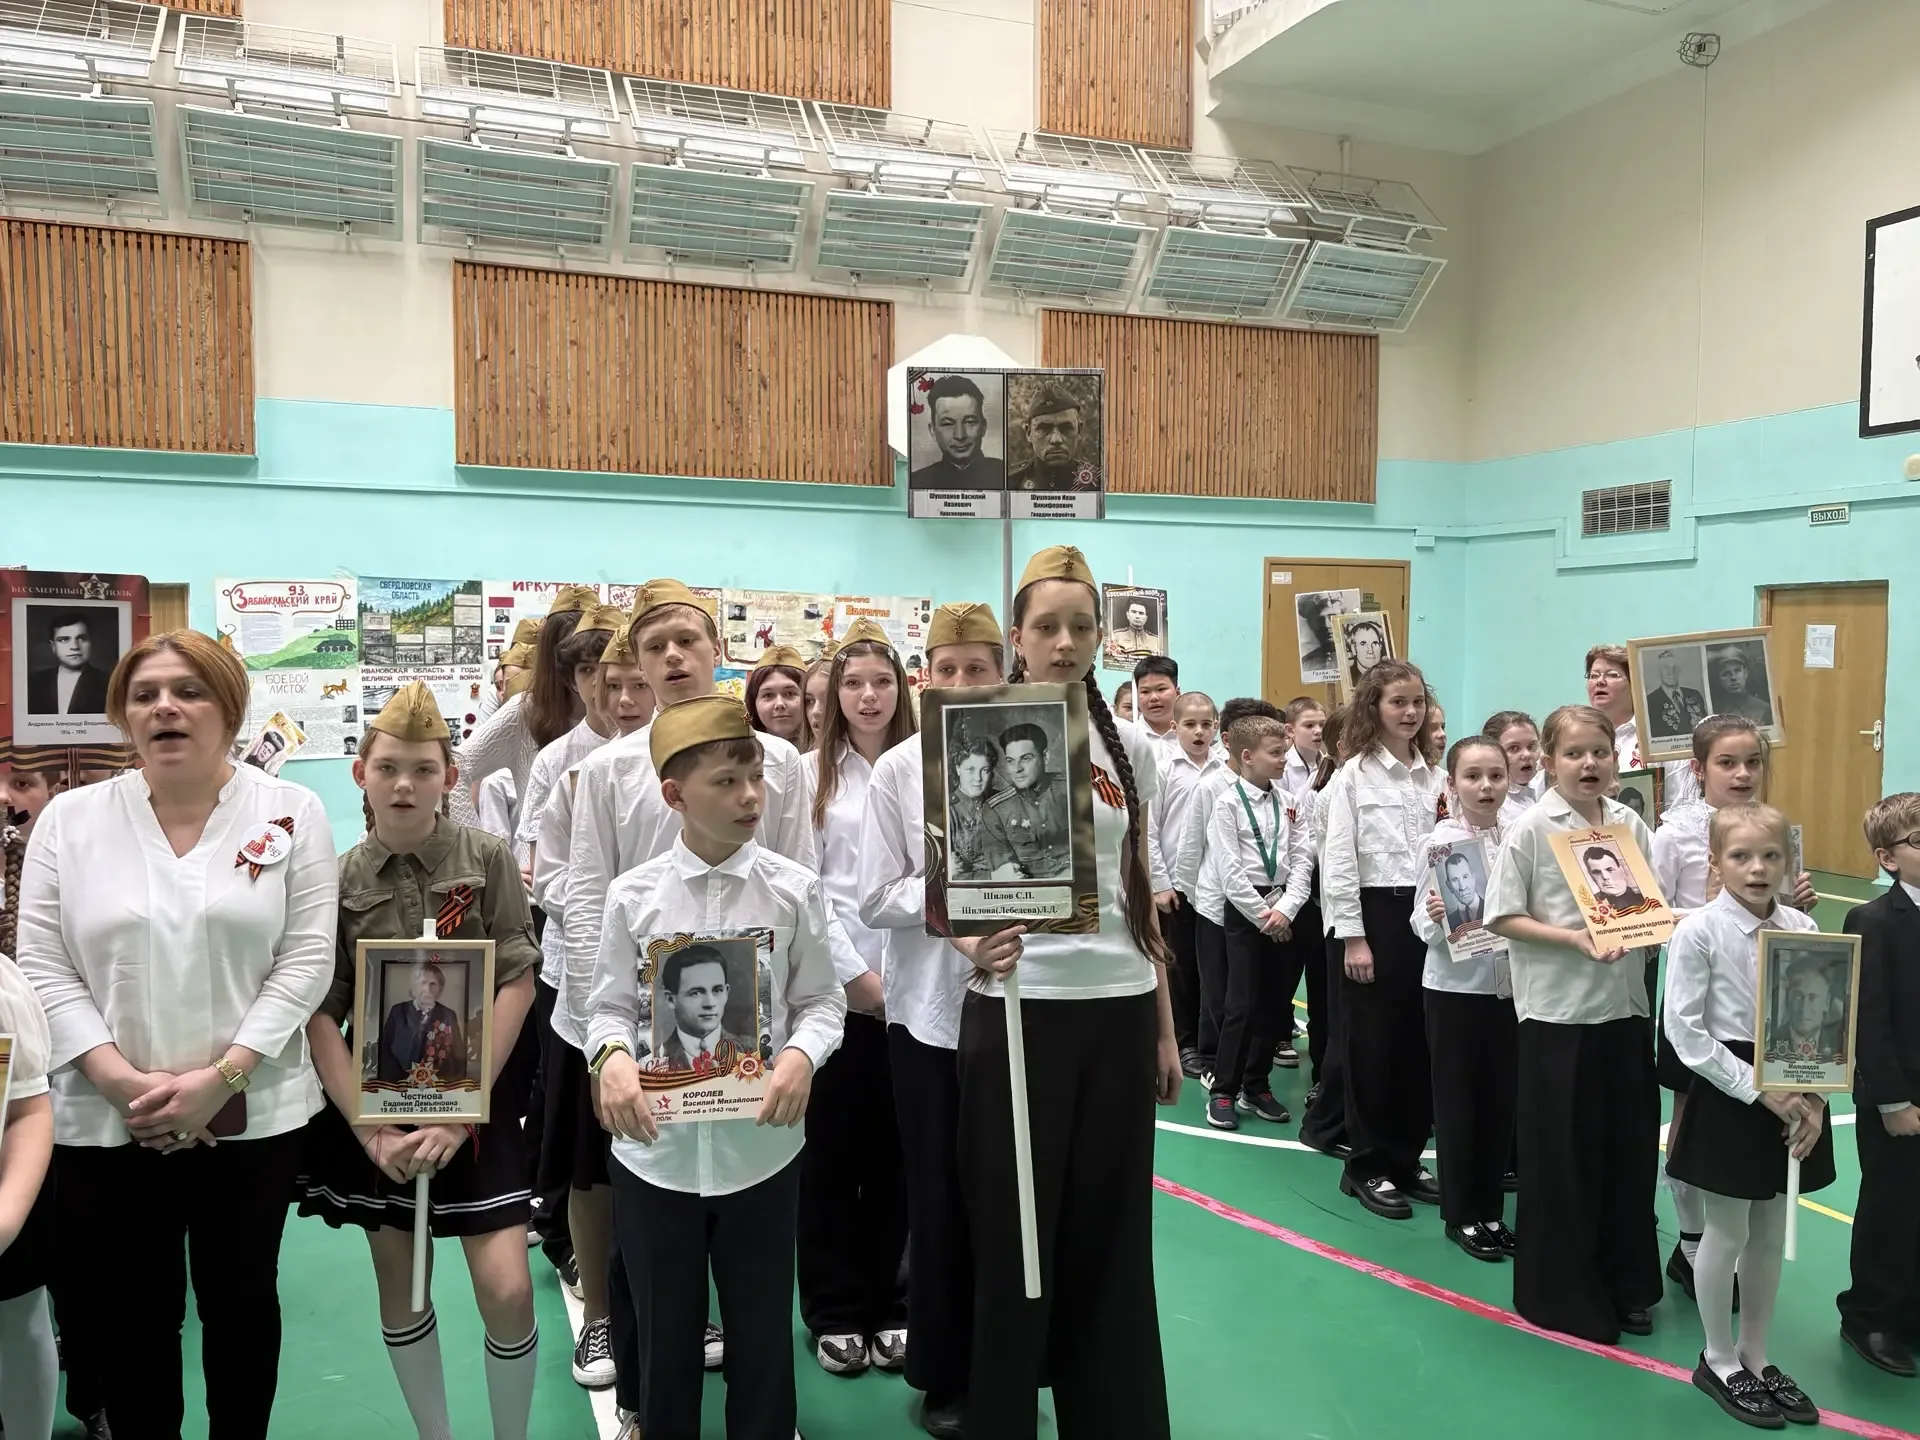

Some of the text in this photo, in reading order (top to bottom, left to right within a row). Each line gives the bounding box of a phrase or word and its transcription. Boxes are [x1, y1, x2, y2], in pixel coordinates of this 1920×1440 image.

[1812, 510, 1846, 522] ВЫХОД
[11, 586, 83, 595] БЕССМЕРТНЫЙ
[380, 581, 432, 591] СВЕРДЛОВСКАЯ
[512, 581, 601, 595] ИРКУТЯ
[314, 592, 338, 605] КРАЙ
[391, 591, 421, 600] ОБЛАСТЬ
[265, 673, 310, 684] БОЕВОЙ
[361, 674, 393, 682] ВЕЛИКОЙ
[397, 673, 454, 681] ОТЕЧЕСТВЕННОЙ
[269, 684, 308, 695] ЛИСТОК
[983, 891, 1035, 900] Шилов С.П.
[1596, 919, 1672, 936] МОЛЧАНОВ АФАНАСИЙ АНДРЕЕВИЧ
[401, 1092, 443, 1100] Честнова
[682, 1089, 724, 1099] КОРОЛЕВ
[383, 1100, 413, 1108] Евдокия
[682, 1096, 764, 1107] Василий Михайлович
